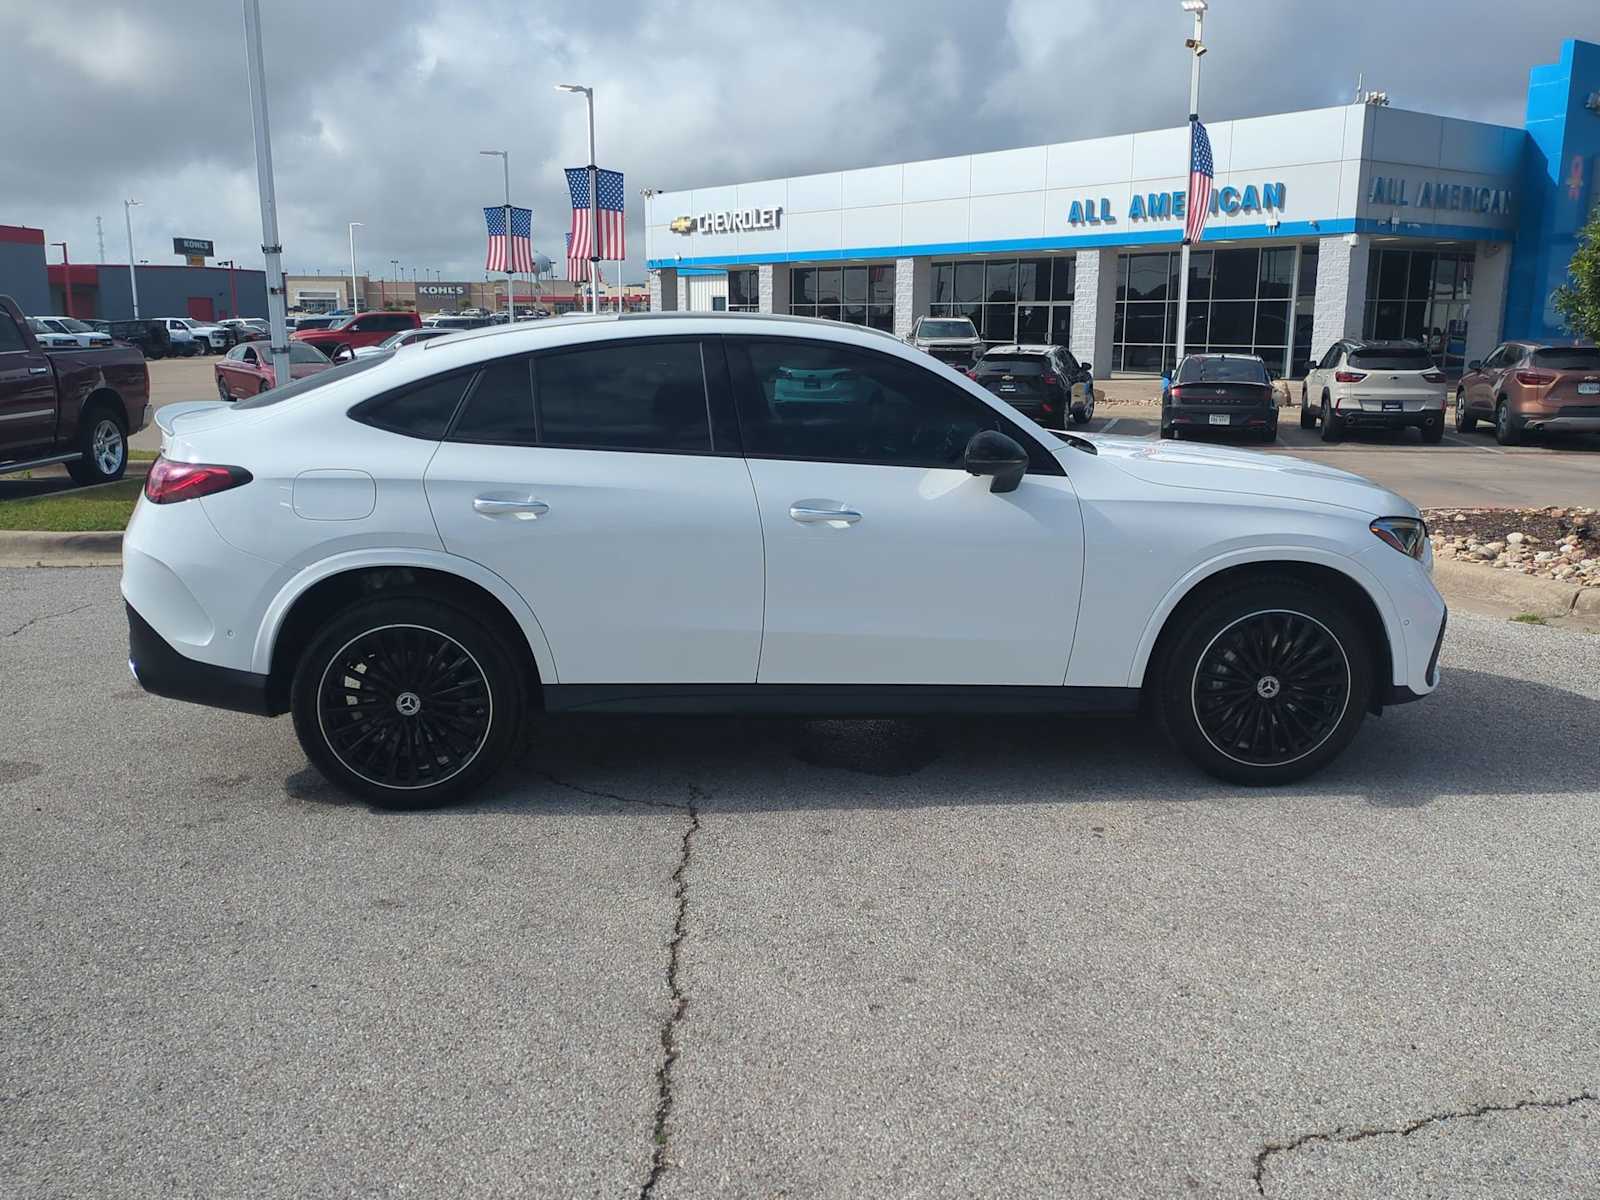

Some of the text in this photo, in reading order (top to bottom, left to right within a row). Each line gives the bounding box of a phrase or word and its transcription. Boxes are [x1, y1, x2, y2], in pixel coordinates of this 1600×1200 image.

[695, 207, 783, 234] CHEVROLET
[1067, 182, 1286, 227] ALL AMEICAN
